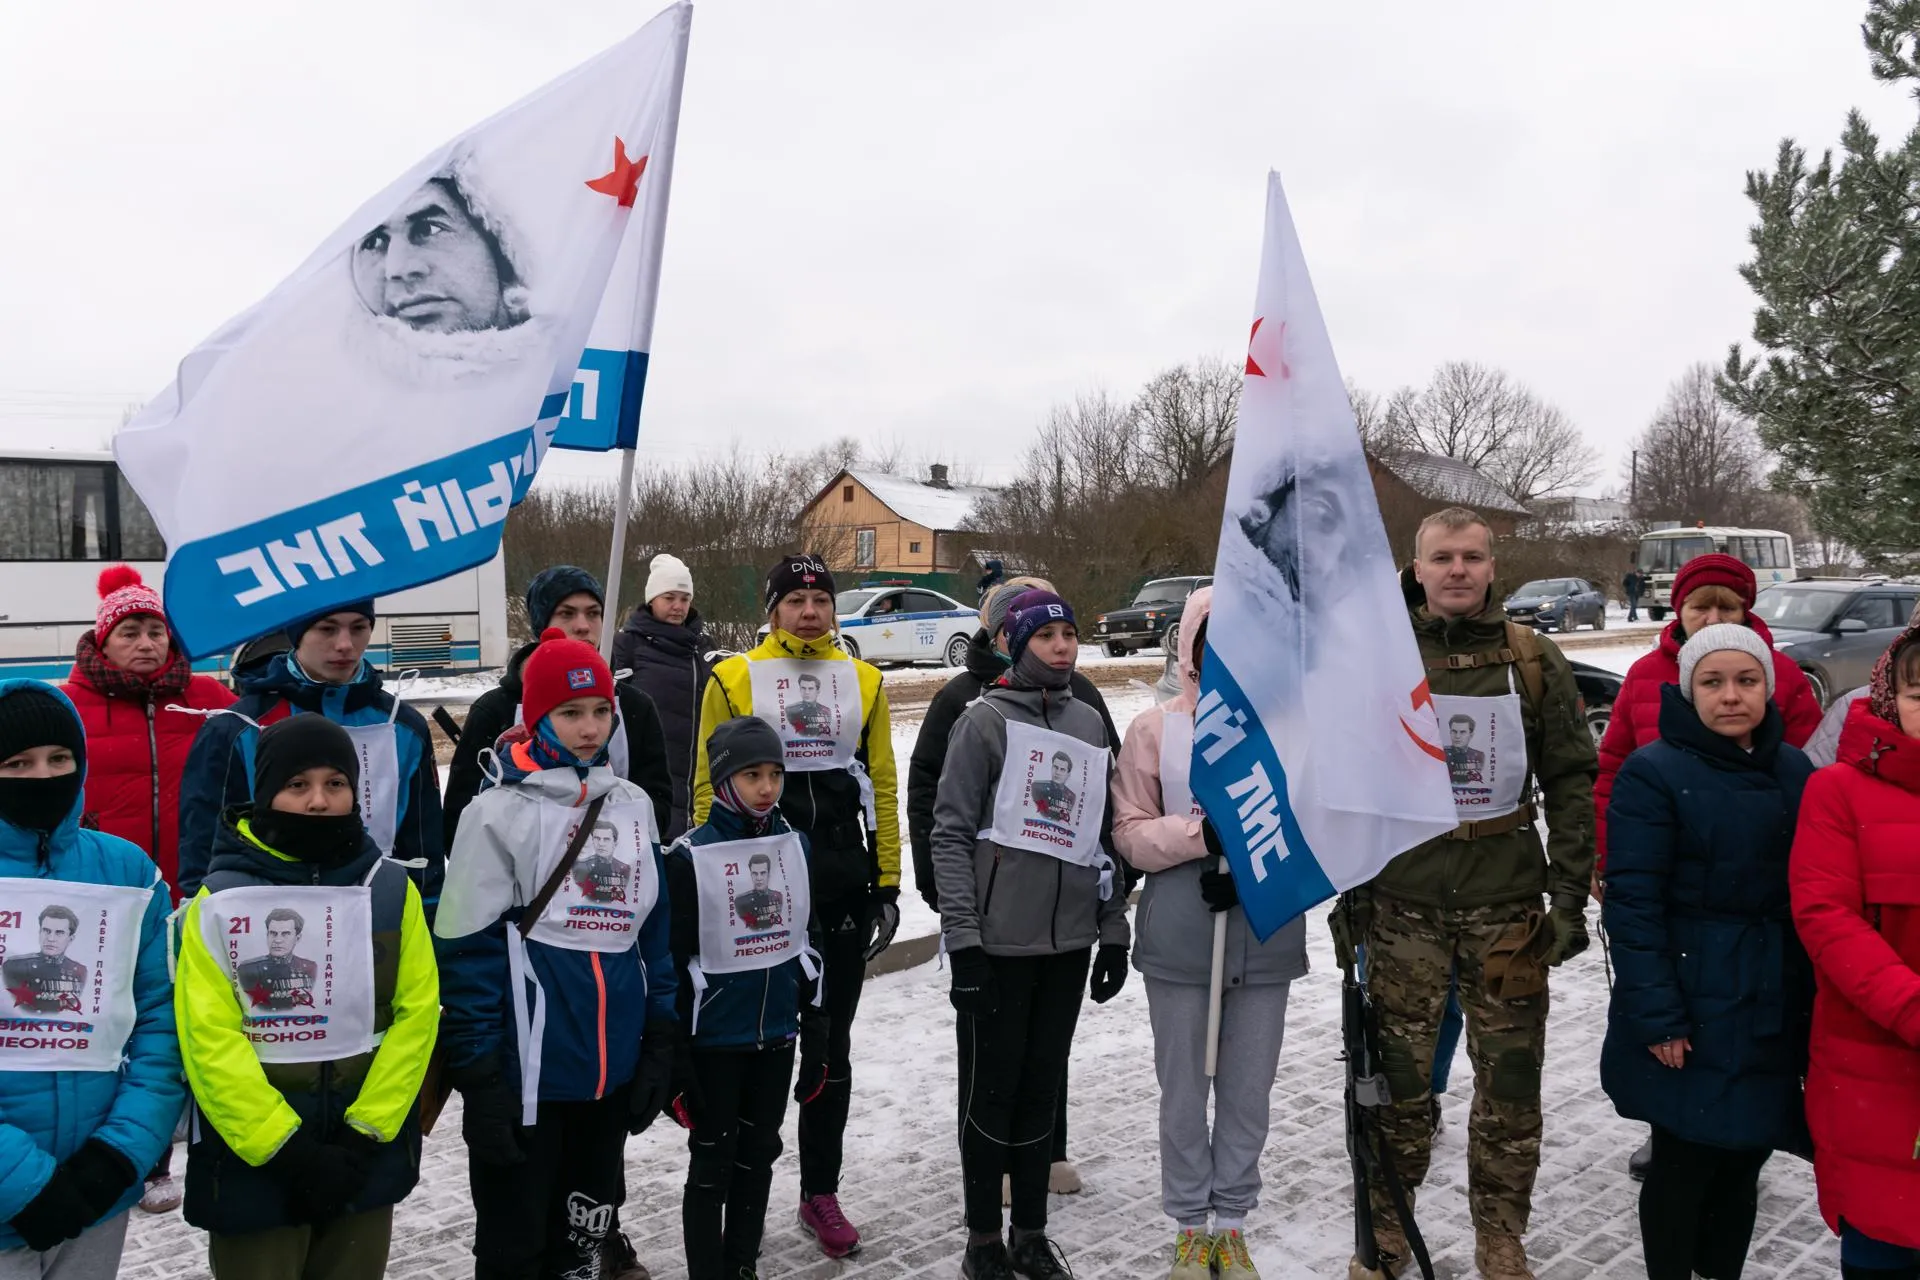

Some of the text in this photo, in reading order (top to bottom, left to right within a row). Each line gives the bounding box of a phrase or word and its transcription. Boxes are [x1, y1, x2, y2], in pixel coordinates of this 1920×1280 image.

[791, 561, 825, 574] DNB
[920, 634, 934, 645] 112
[776, 678, 790, 690] 21
[786, 740, 836, 749] ВИКТОР
[785, 750, 833, 758] ЛЕОНОВ
[1029, 749, 1044, 763] 21
[1023, 764, 1035, 807] НОЯБРЯ
[1452, 787, 1491, 796] КТОР
[364, 780, 372, 819] ПАМЯТИ
[1024, 818, 1074, 838] ВИКТОР
[1020, 829, 1073, 848] ЛЕОНОВ
[633, 820, 641, 903] ЗАБЕГ ПАМЯТИ
[725, 863, 740, 876] 21
[727, 880, 736, 926] НОЯБРЯ
[0, 911, 22, 928] 21
[568, 906, 632, 919] ВИКТОР
[229, 917, 251, 934] 21
[563, 920, 632, 932] ЛЕОНОВ
[735, 930, 790, 946] ВИКТОР
[324, 906, 333, 1006] ЗАБЕГ ПАМЯТИ
[734, 940, 790, 957] ЛЕОНОВ
[92, 910, 108, 1013] ЗАБЕГ ПАМЯТИ
